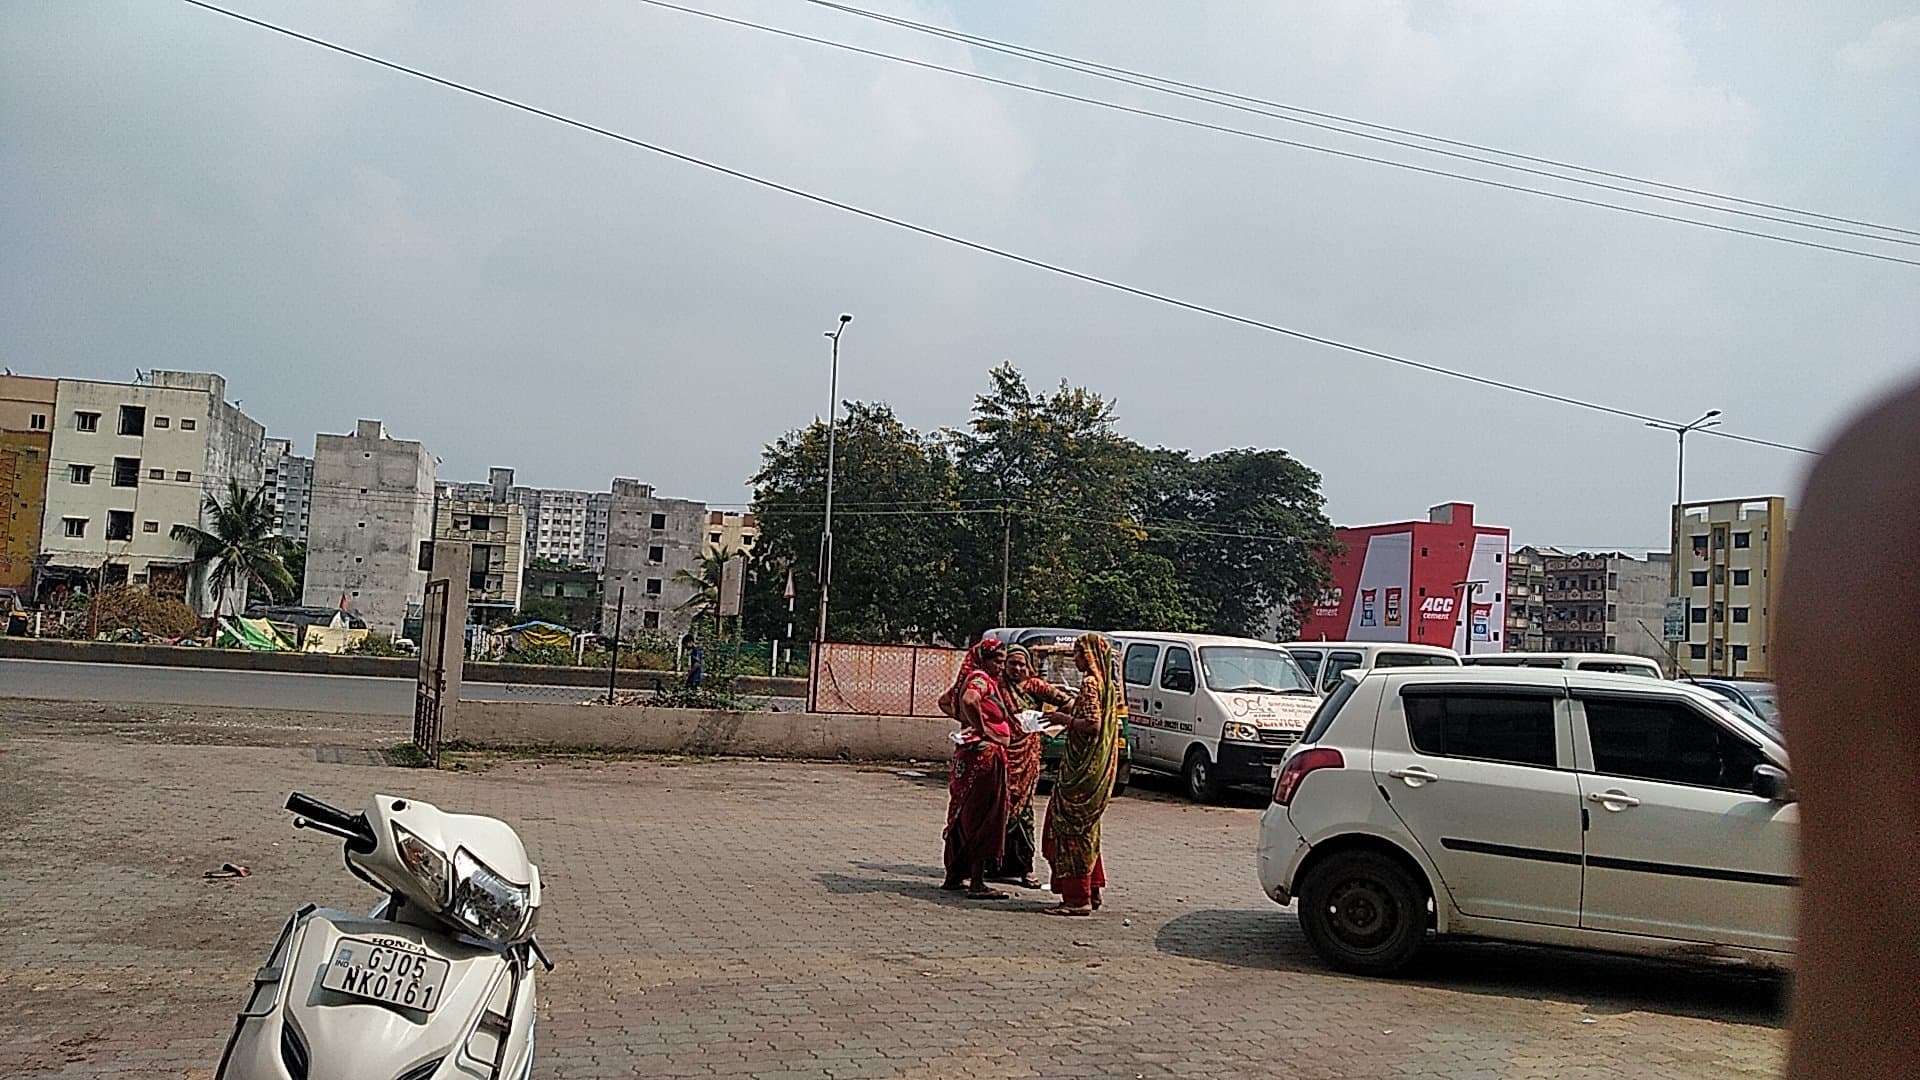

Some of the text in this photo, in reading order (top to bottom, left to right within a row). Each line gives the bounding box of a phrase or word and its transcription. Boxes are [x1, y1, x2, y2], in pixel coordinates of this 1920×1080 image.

[1419, 597, 1454, 612] ACC
[1423, 612, 1450, 620] cement
[1255, 718, 1303, 728] SERVICE
[371, 937, 429, 956] HONDA
[335, 959, 349, 968] IND
[368, 947, 427, 981] GJ05
[341, 966, 434, 1009] NK0161
